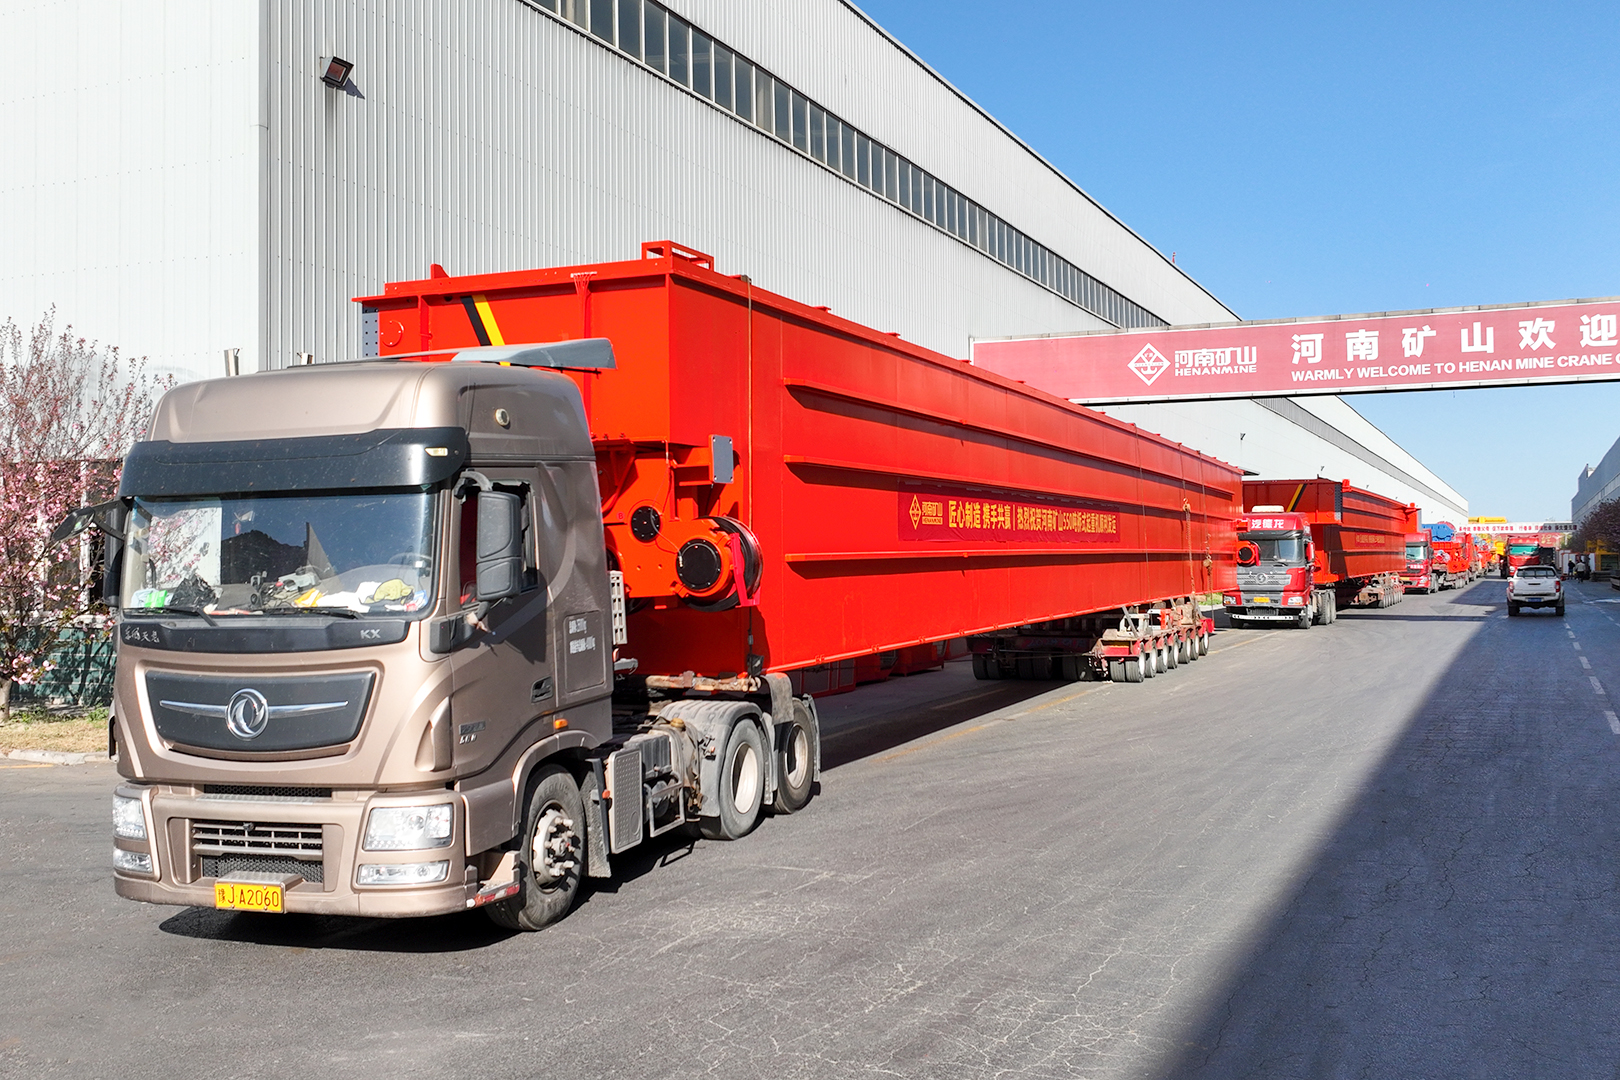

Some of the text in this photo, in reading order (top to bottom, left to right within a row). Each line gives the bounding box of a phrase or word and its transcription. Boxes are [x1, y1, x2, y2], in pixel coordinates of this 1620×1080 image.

[1174, 346, 1257, 368] 河南矿山
[1174, 364, 1257, 377] HENANMINE
[1291, 367, 1354, 382] WARMLY
[1356, 363, 1431, 378] WELCOME
[1434, 362, 1456, 374] TO
[1458, 359, 1513, 373] HENAN
[1515, 356, 1554, 370] MINE
[1557, 353, 1612, 368] CRANE
[360, 629, 381, 639] KX
